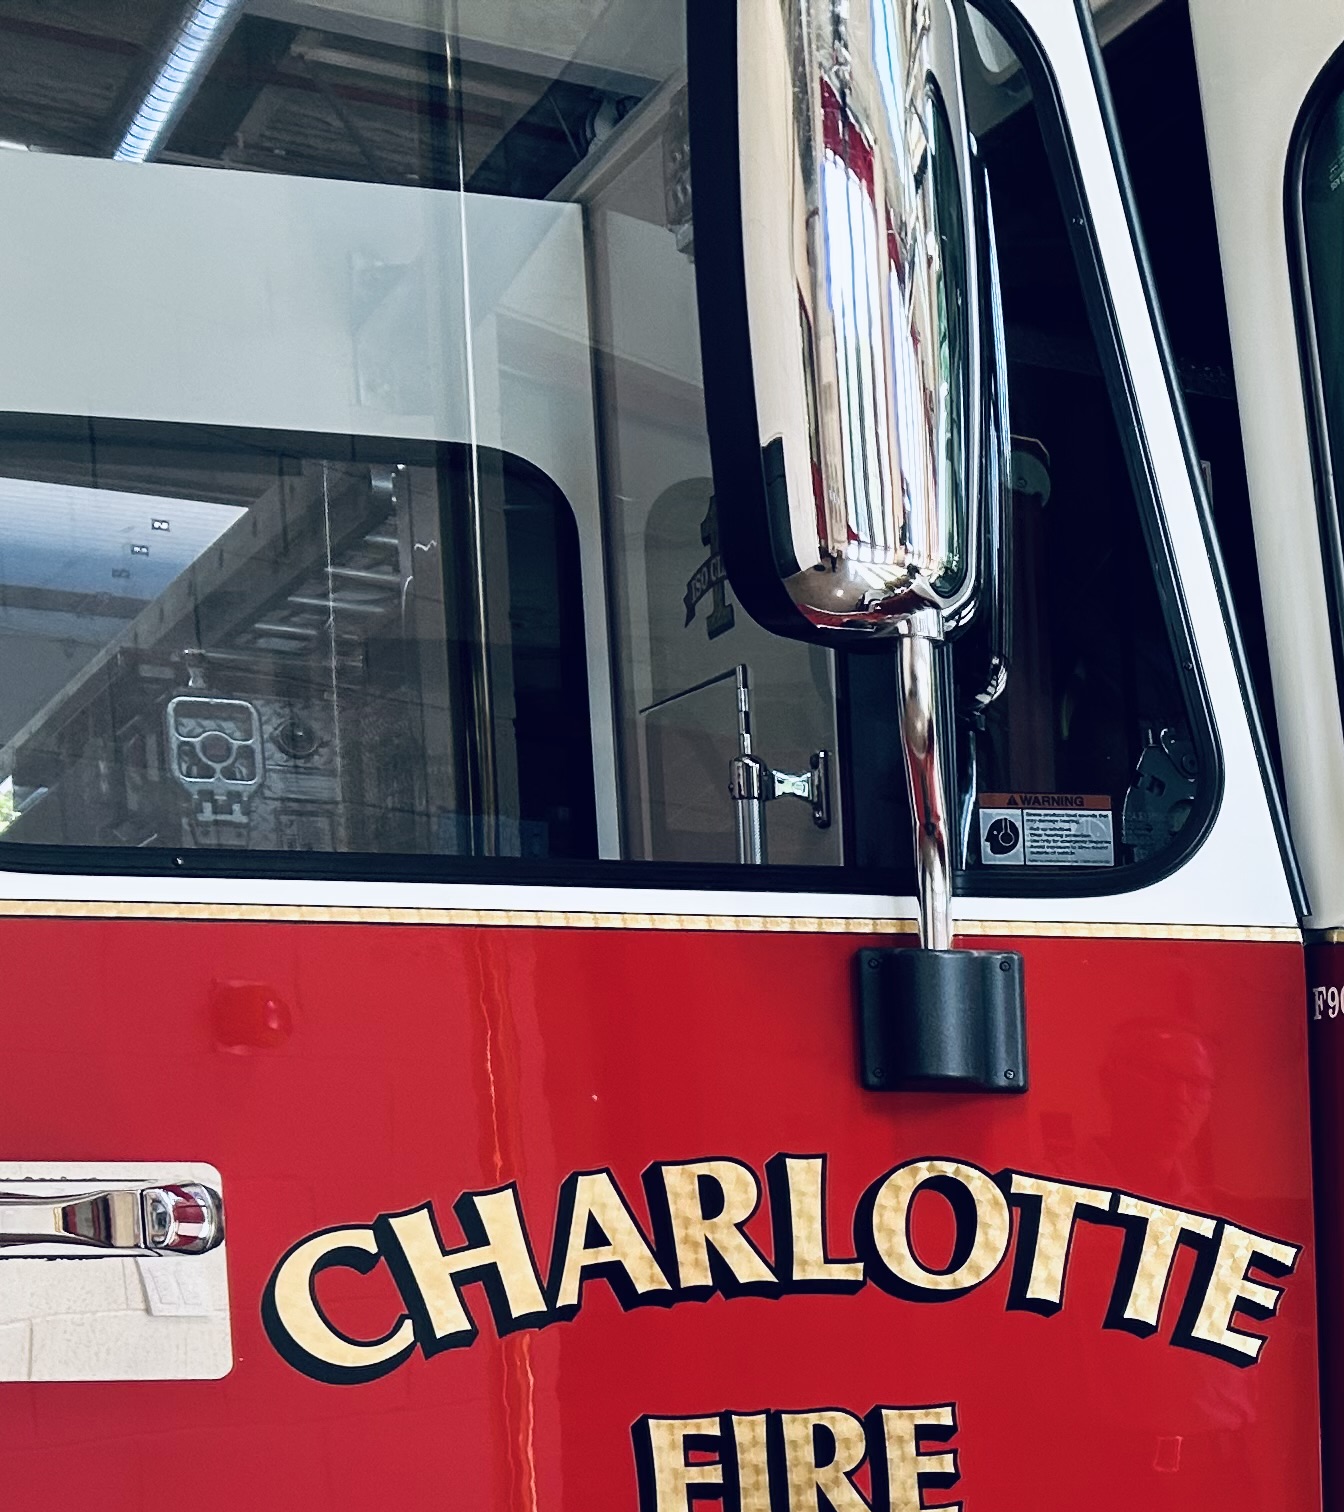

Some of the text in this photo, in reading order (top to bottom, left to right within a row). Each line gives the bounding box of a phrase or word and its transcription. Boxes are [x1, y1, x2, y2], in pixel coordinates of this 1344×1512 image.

[691, 555, 727, 603] ISO CL
[1021, 795, 1084, 807] WARNING
[262, 1153, 1303, 1385] CHARLOTTE
